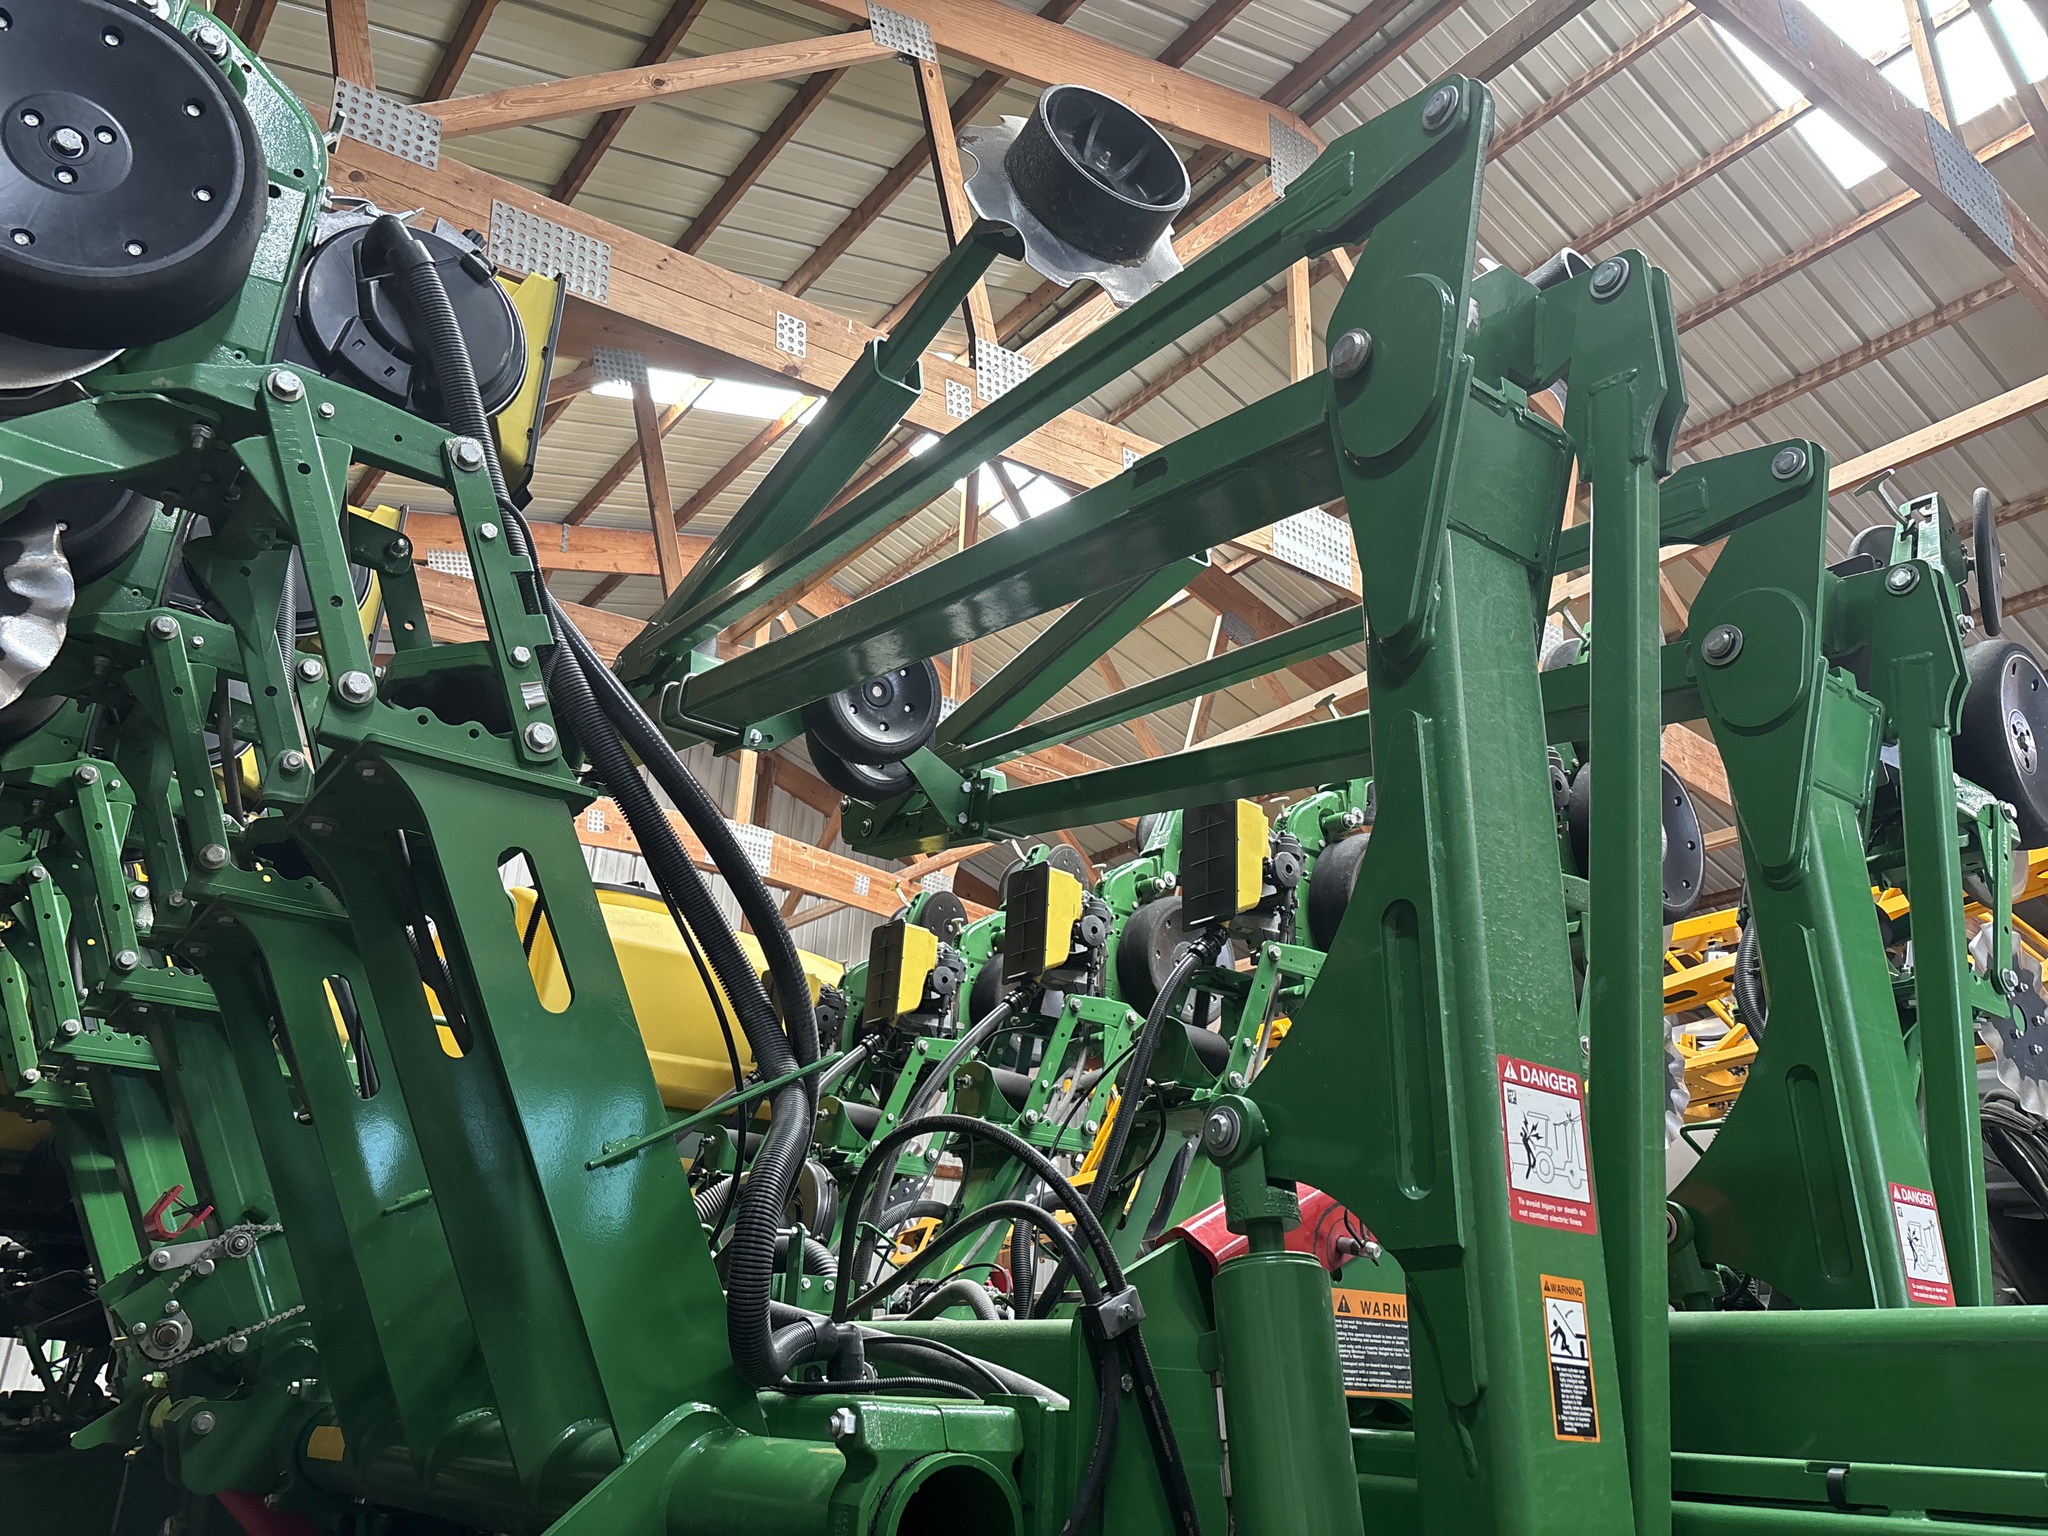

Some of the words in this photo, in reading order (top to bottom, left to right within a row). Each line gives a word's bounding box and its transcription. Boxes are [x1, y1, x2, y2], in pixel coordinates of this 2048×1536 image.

[1520, 1065, 1577, 1095] DANGER
[1901, 1188, 1933, 1206] DANGER
[1518, 1197, 1525, 1205] To
[1541, 1202, 1556, 1212] injury
[1564, 1207, 1578, 1215] death
[1529, 1212, 1548, 1221] contact
[1550, 1284, 1582, 1297] WARNING
[1360, 1301, 1405, 1318] WARNI
